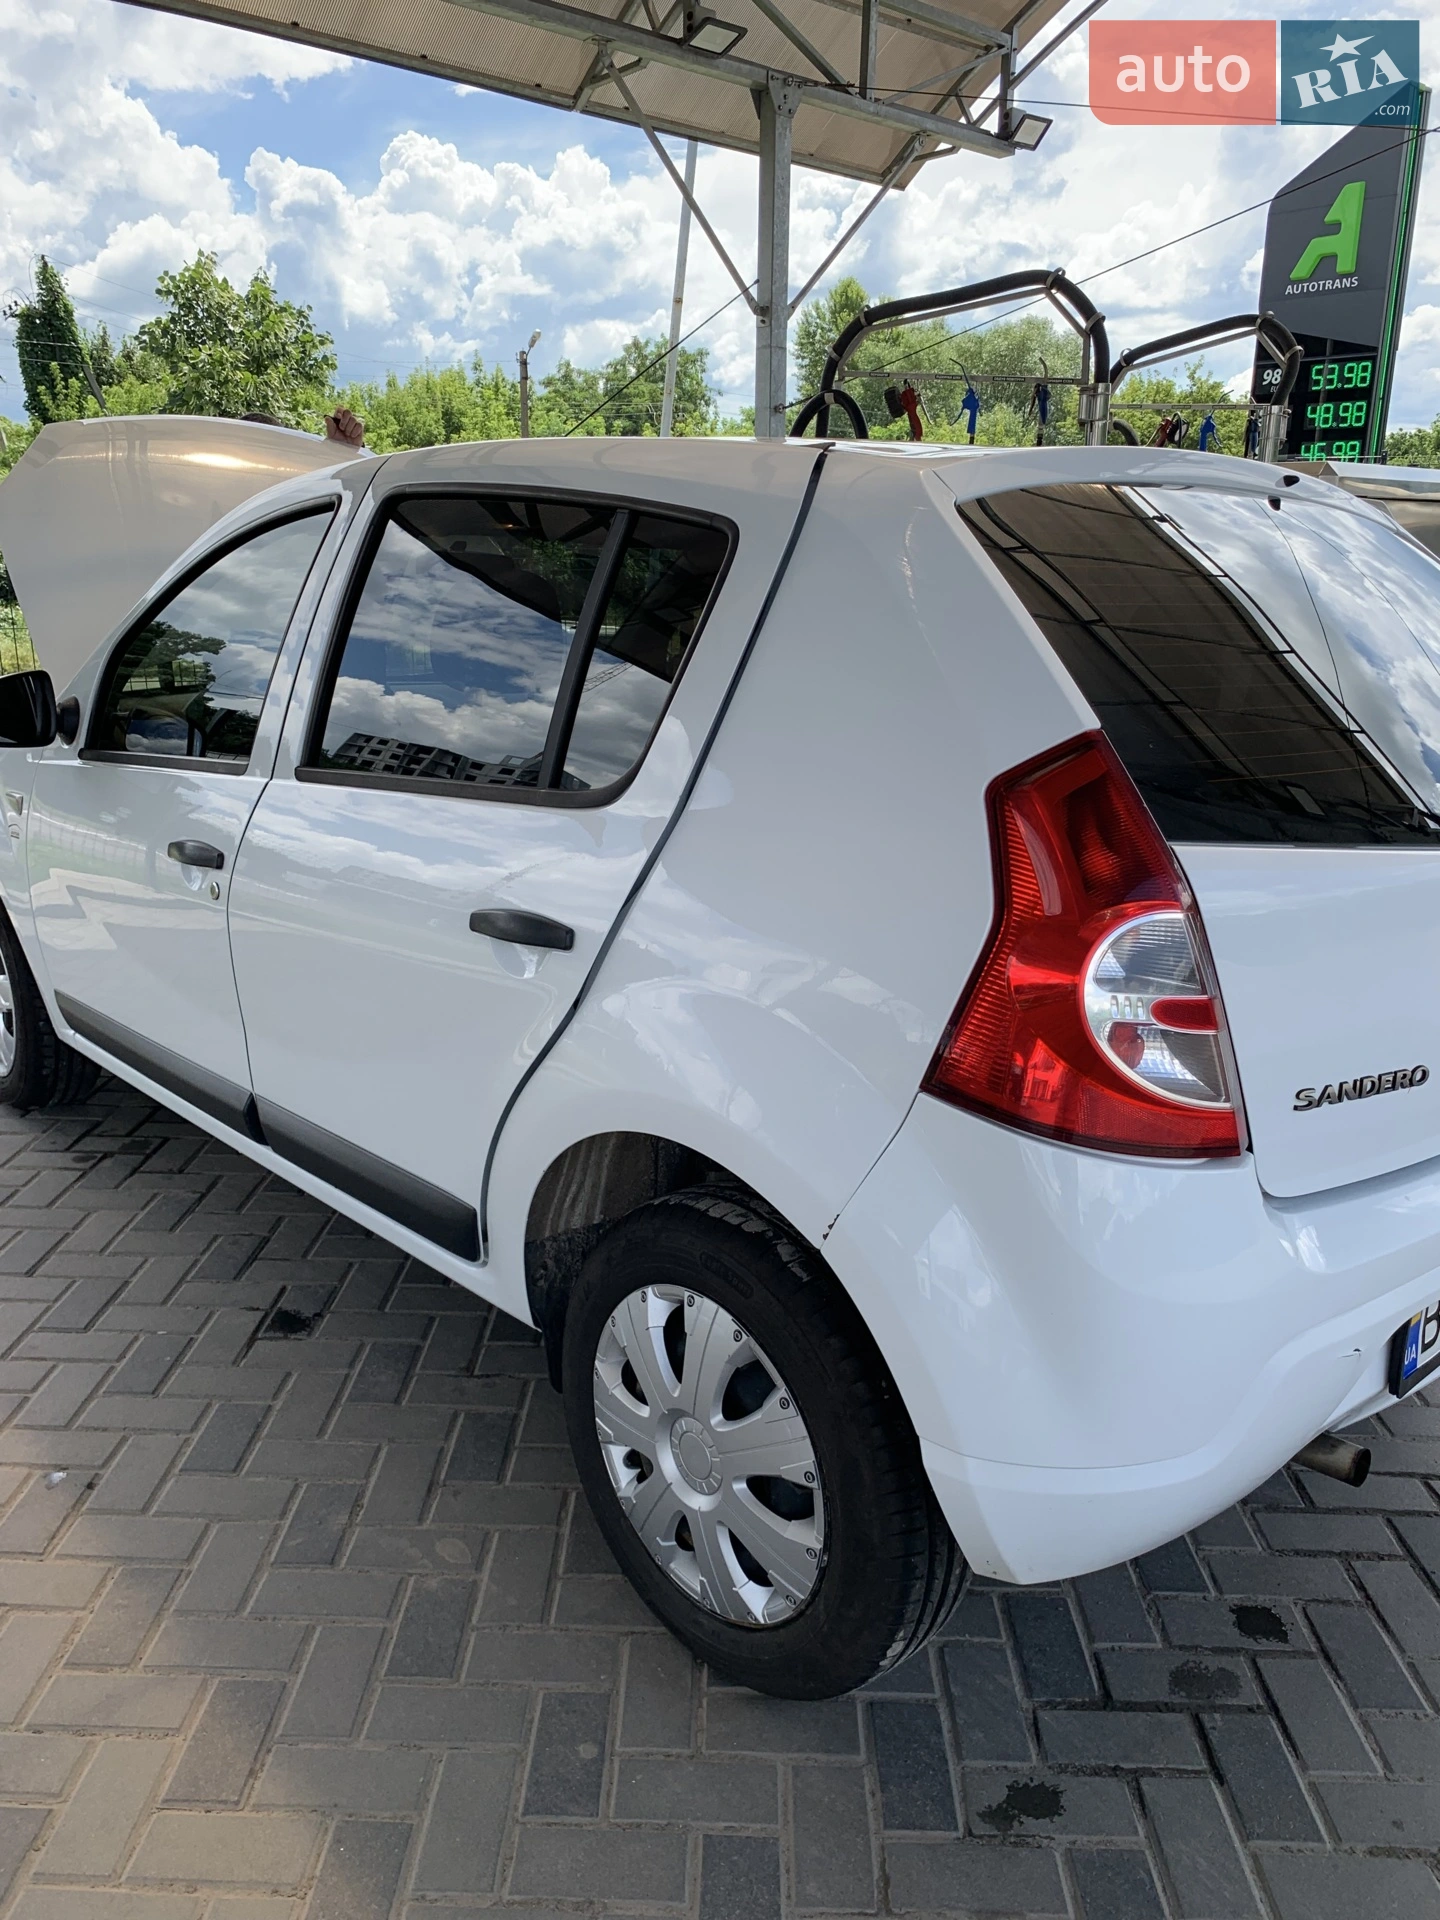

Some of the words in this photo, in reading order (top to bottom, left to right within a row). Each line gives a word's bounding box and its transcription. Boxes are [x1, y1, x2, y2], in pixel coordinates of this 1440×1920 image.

[1284, 276, 1359, 295] AUTOTRANS
[1262, 368, 1283, 386] 98
[1311, 362, 1372, 391] 53.98
[1307, 401, 1367, 428] 48.98
[1301, 441, 1360, 463] 4698
[1293, 1064, 1430, 1111] SANDERO
[1404, 1344, 1417, 1366] UA
